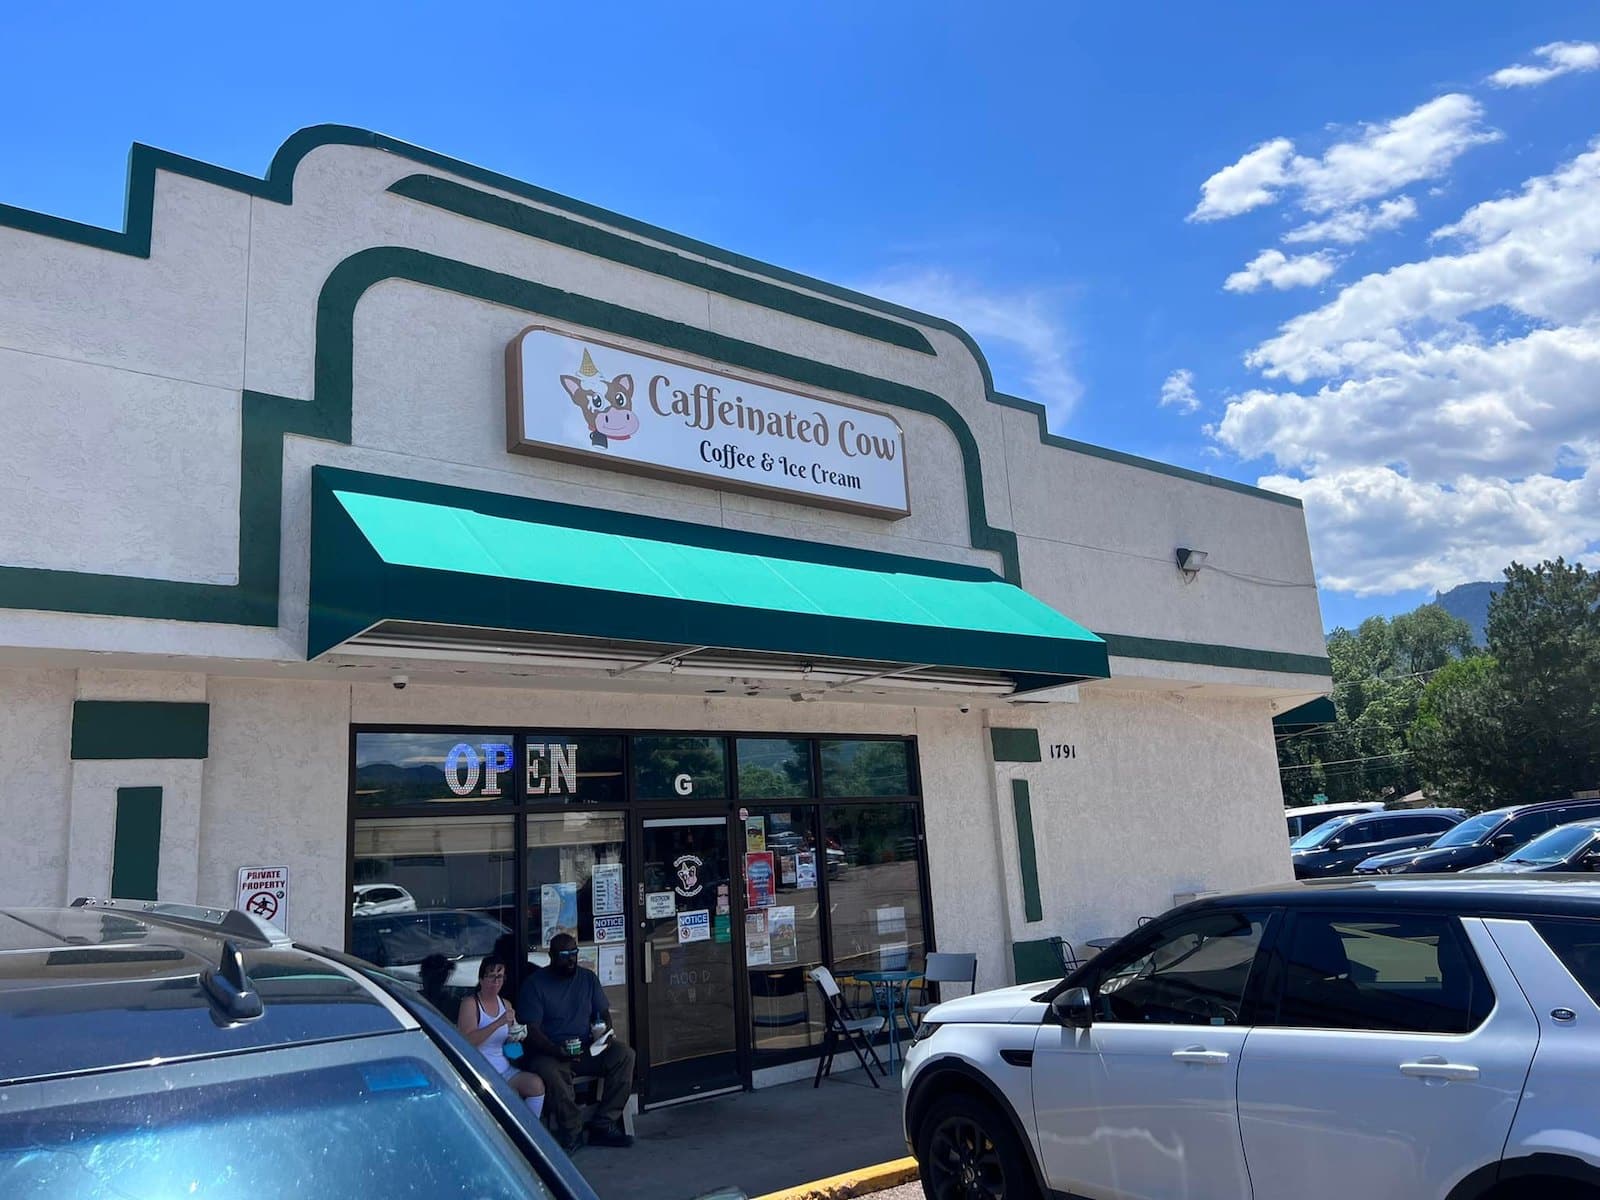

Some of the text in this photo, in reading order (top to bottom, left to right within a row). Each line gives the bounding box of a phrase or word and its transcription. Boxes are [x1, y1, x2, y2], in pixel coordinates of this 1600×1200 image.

[649, 375, 896, 461] Caffeinated Cow
[699, 439, 861, 489] Coffee & Ice Cream
[1050, 744, 1076, 759] 1791
[444, 743, 578, 796] OPEN
[674, 773, 693, 796] G
[247, 870, 281, 879] PRIVATE
[242, 880, 285, 890] PROPERTY
[595, 917, 624, 928] NOTICE
[679, 913, 708, 926] NOTICE
